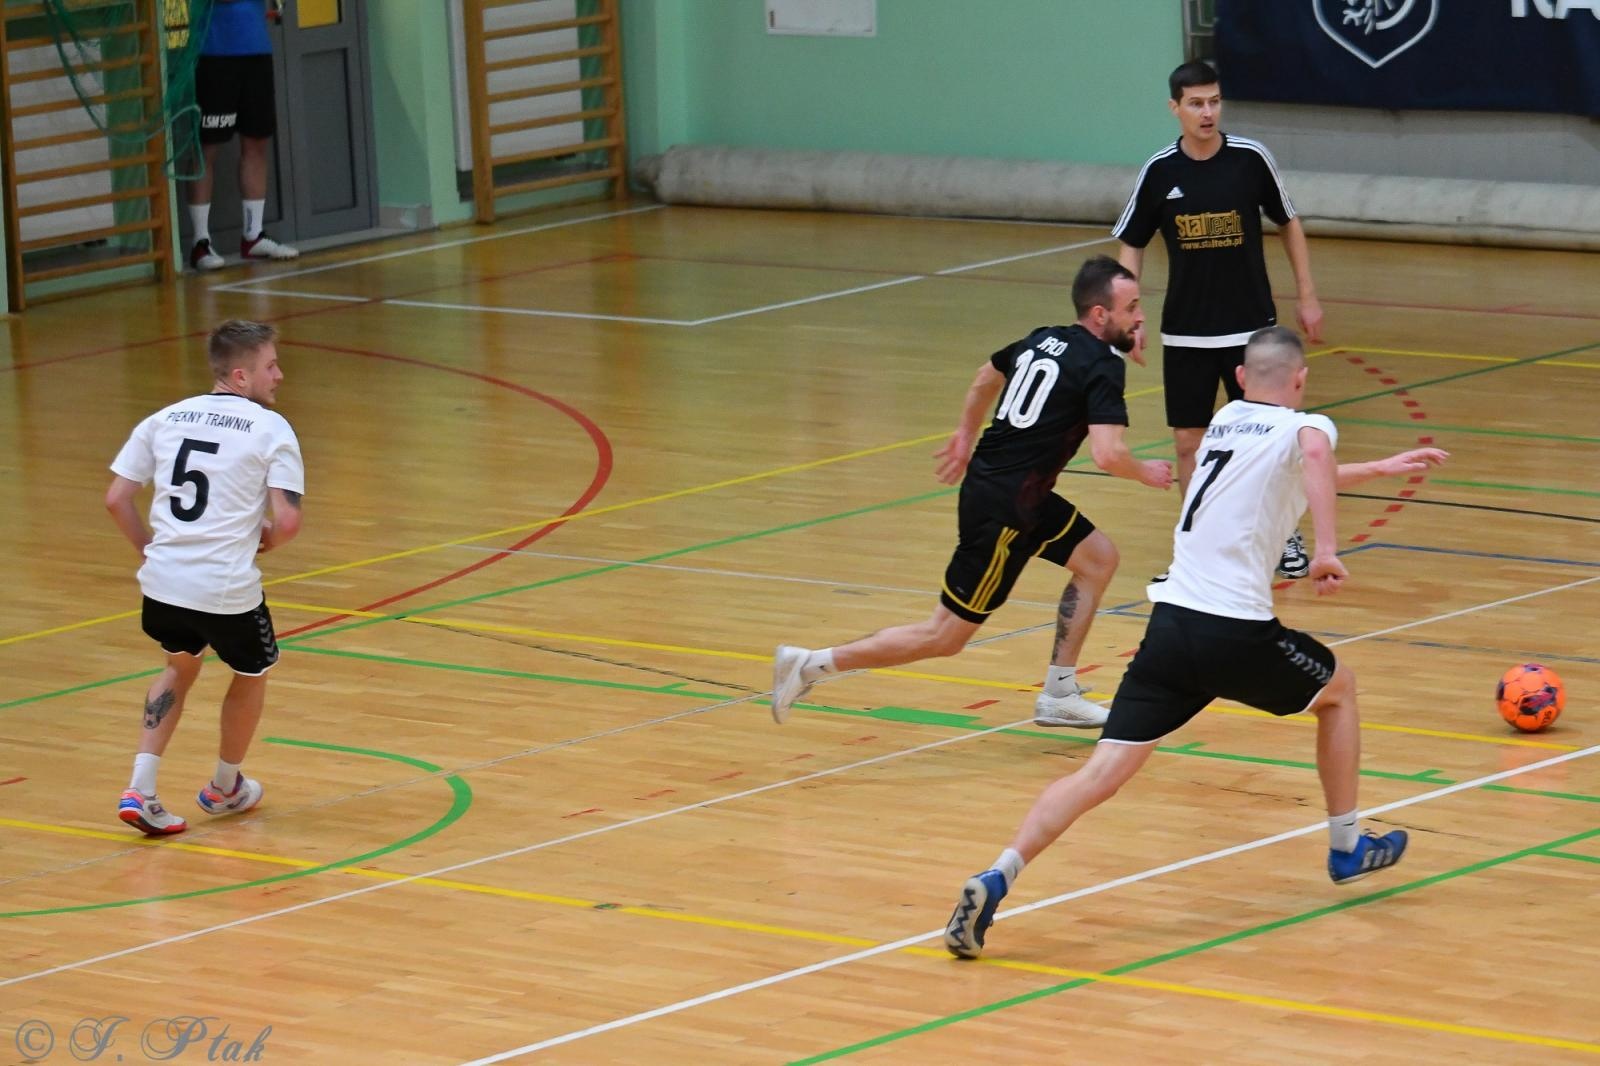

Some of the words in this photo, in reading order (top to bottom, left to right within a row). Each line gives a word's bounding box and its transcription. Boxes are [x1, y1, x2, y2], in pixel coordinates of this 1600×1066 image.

[205, 413, 254, 433] TRAWNIK
[996, 349, 1060, 429] 10
[169, 438, 220, 522] 5
[1182, 449, 1234, 532] 7
